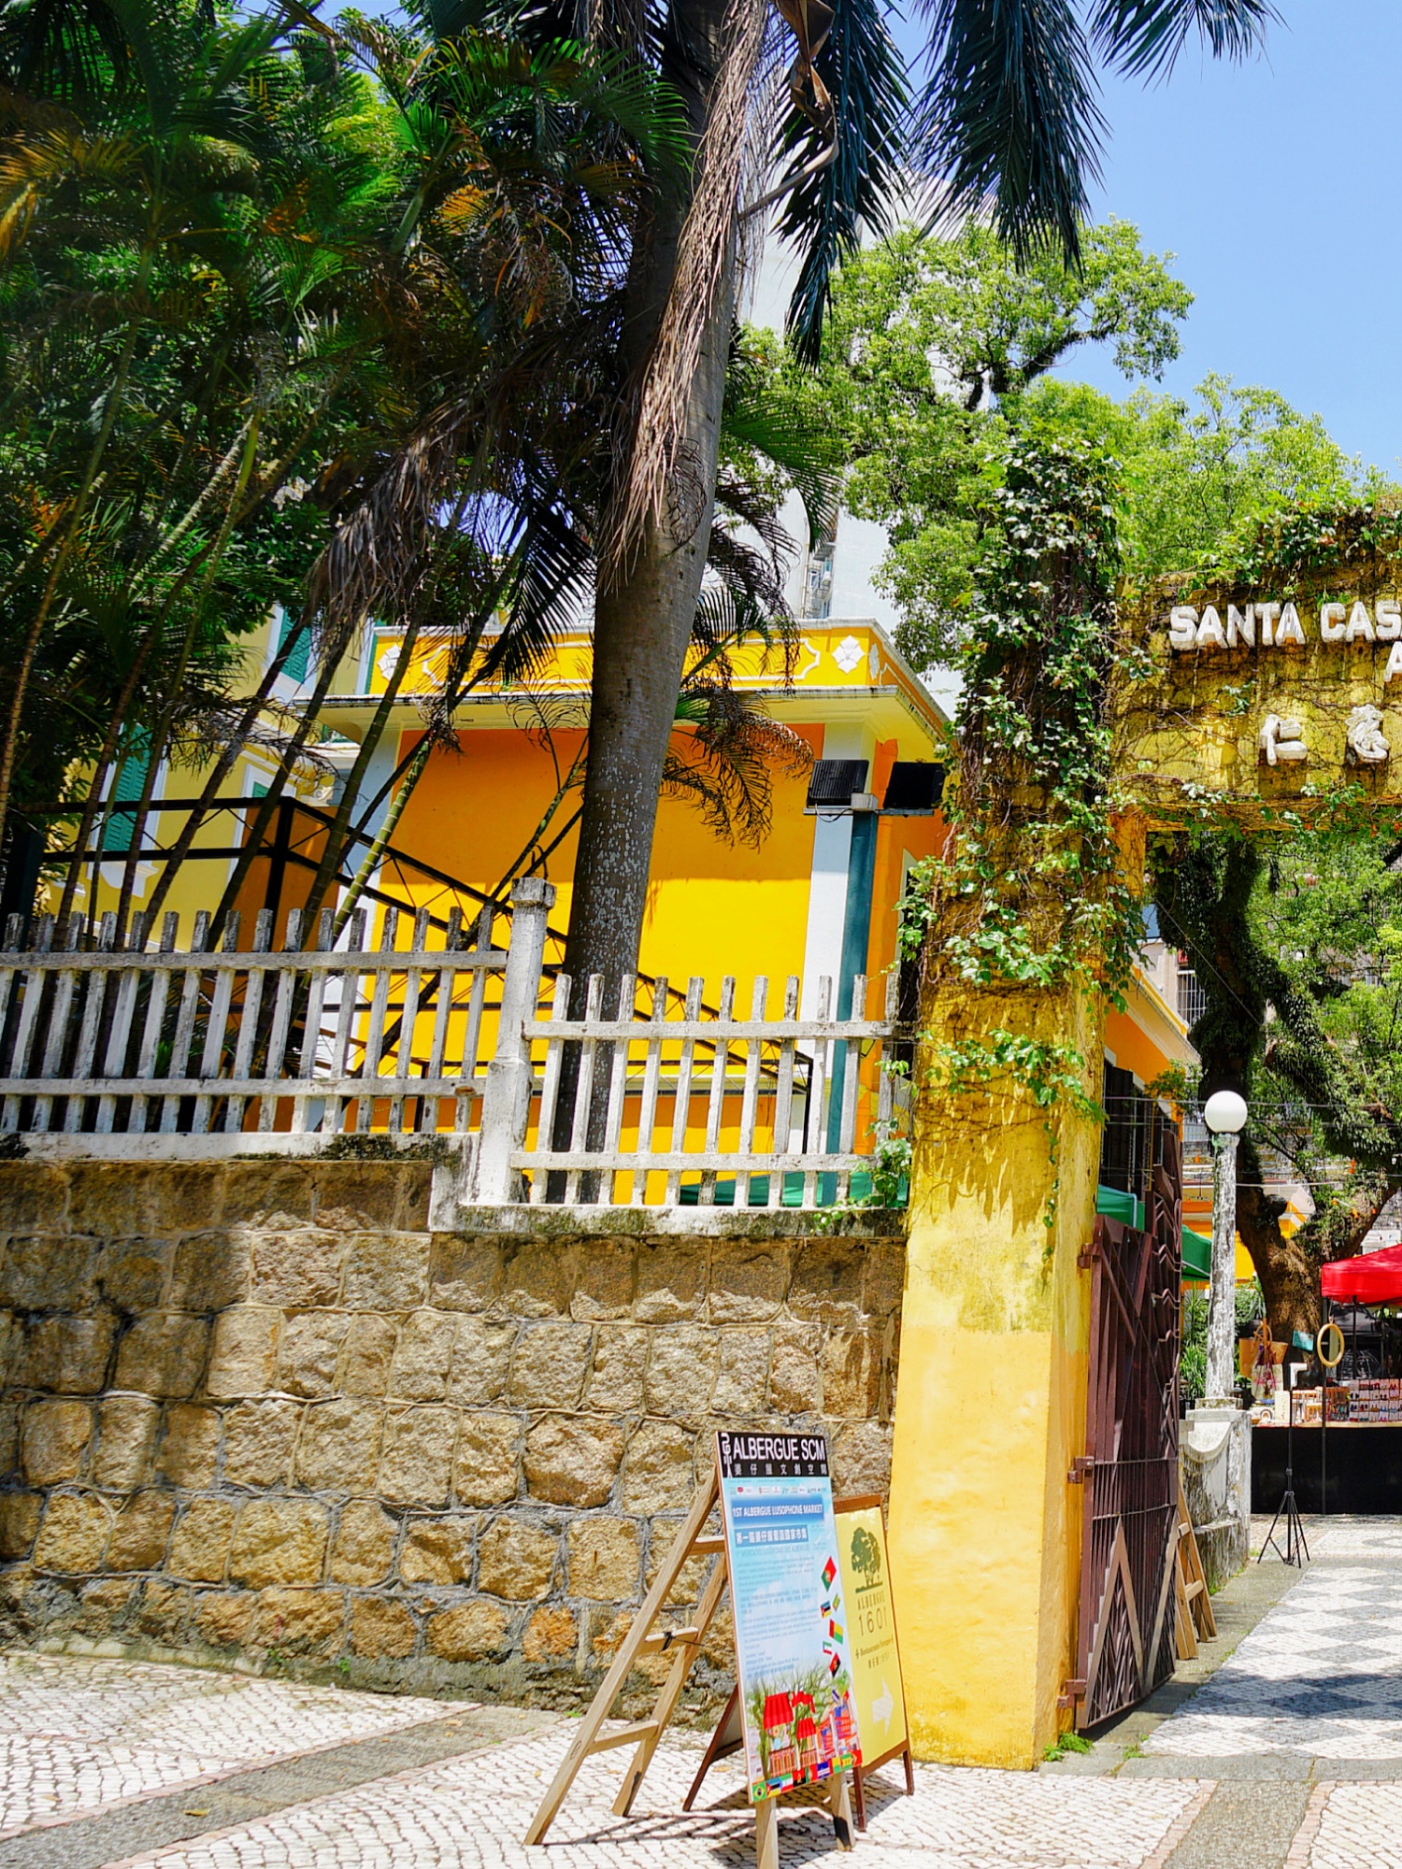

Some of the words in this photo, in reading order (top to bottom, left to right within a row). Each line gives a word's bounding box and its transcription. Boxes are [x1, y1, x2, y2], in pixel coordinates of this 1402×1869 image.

[1169, 601, 1306, 650] SANTA
[733, 1436, 800, 1461] ALBERGUE
[801, 1439, 826, 1461] SCM
[732, 1506, 743, 1517] 1ST
[743, 1505, 771, 1517] ALBERGUE
[772, 1504, 802, 1516] LUSOPHONE
[803, 1503, 823, 1514] MARKET
[858, 1606, 888, 1637] 1601
